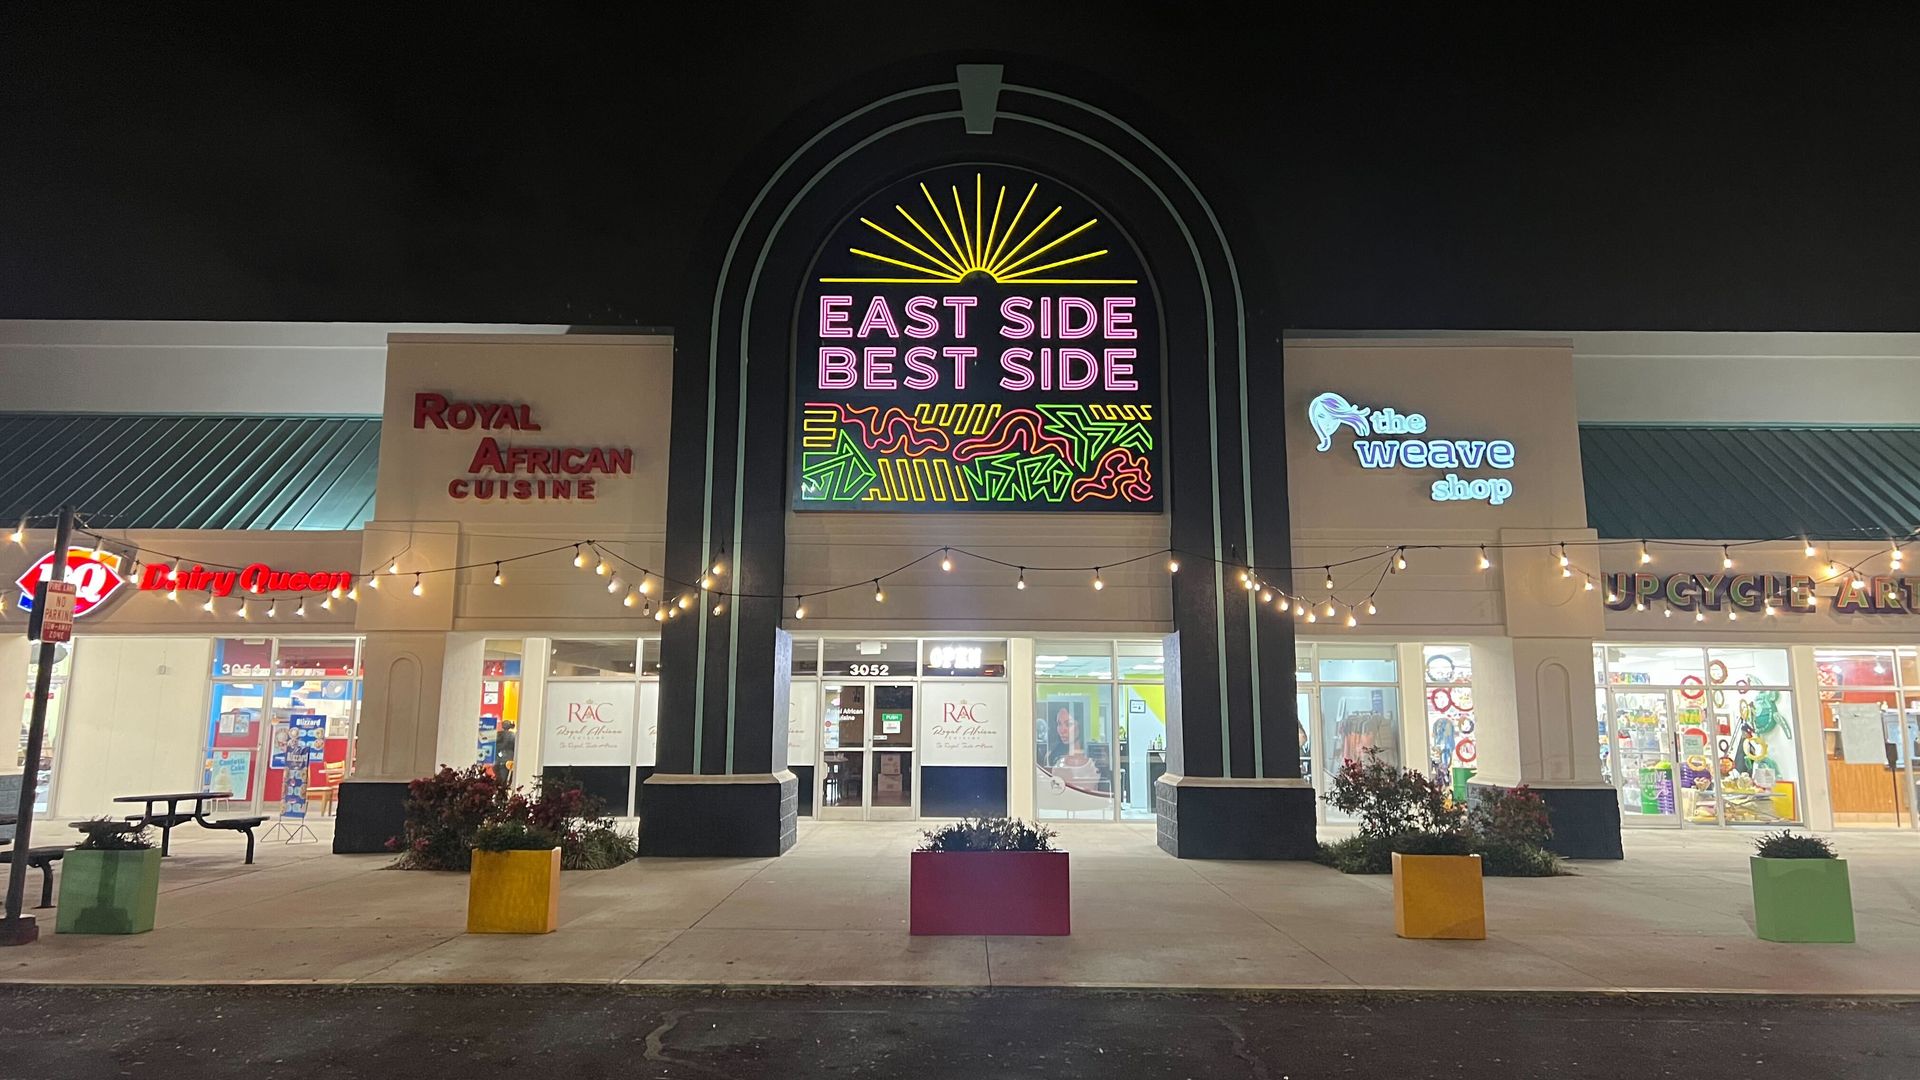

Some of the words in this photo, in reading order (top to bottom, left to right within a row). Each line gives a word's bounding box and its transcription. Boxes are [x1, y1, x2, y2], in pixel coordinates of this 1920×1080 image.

[819, 296, 978, 338] EAST
[999, 297, 1138, 339] SIDE
[818, 347, 977, 389] BEST
[999, 347, 1139, 391] SIDE
[413, 392, 542, 431] ROYAL
[1370, 408, 1427, 434] the
[468, 437, 633, 474] AFRICAN
[1354, 439, 1515, 469] weave
[448, 479, 596, 499] CUISINE
[1431, 474, 1513, 505] shop
[138, 563, 236, 597] Dairy
[239, 562, 351, 594] Queen
[56, 596, 67, 607] NO
[1600, 572, 1815, 613] UPCYCLE
[48, 631, 64, 640] ZONE
[930, 646, 981, 668] OPEN
[222, 664, 262, 675] 3054
[850, 664, 889, 676] 3052
[296, 718, 321, 727] Blizzard
[567, 702, 614, 724] RAC
[943, 702, 989, 724] RAC
[556, 725, 587, 739] Royal
[586, 725, 622, 736] African
[932, 725, 962, 739] Royal
[962, 725, 997, 736] African
